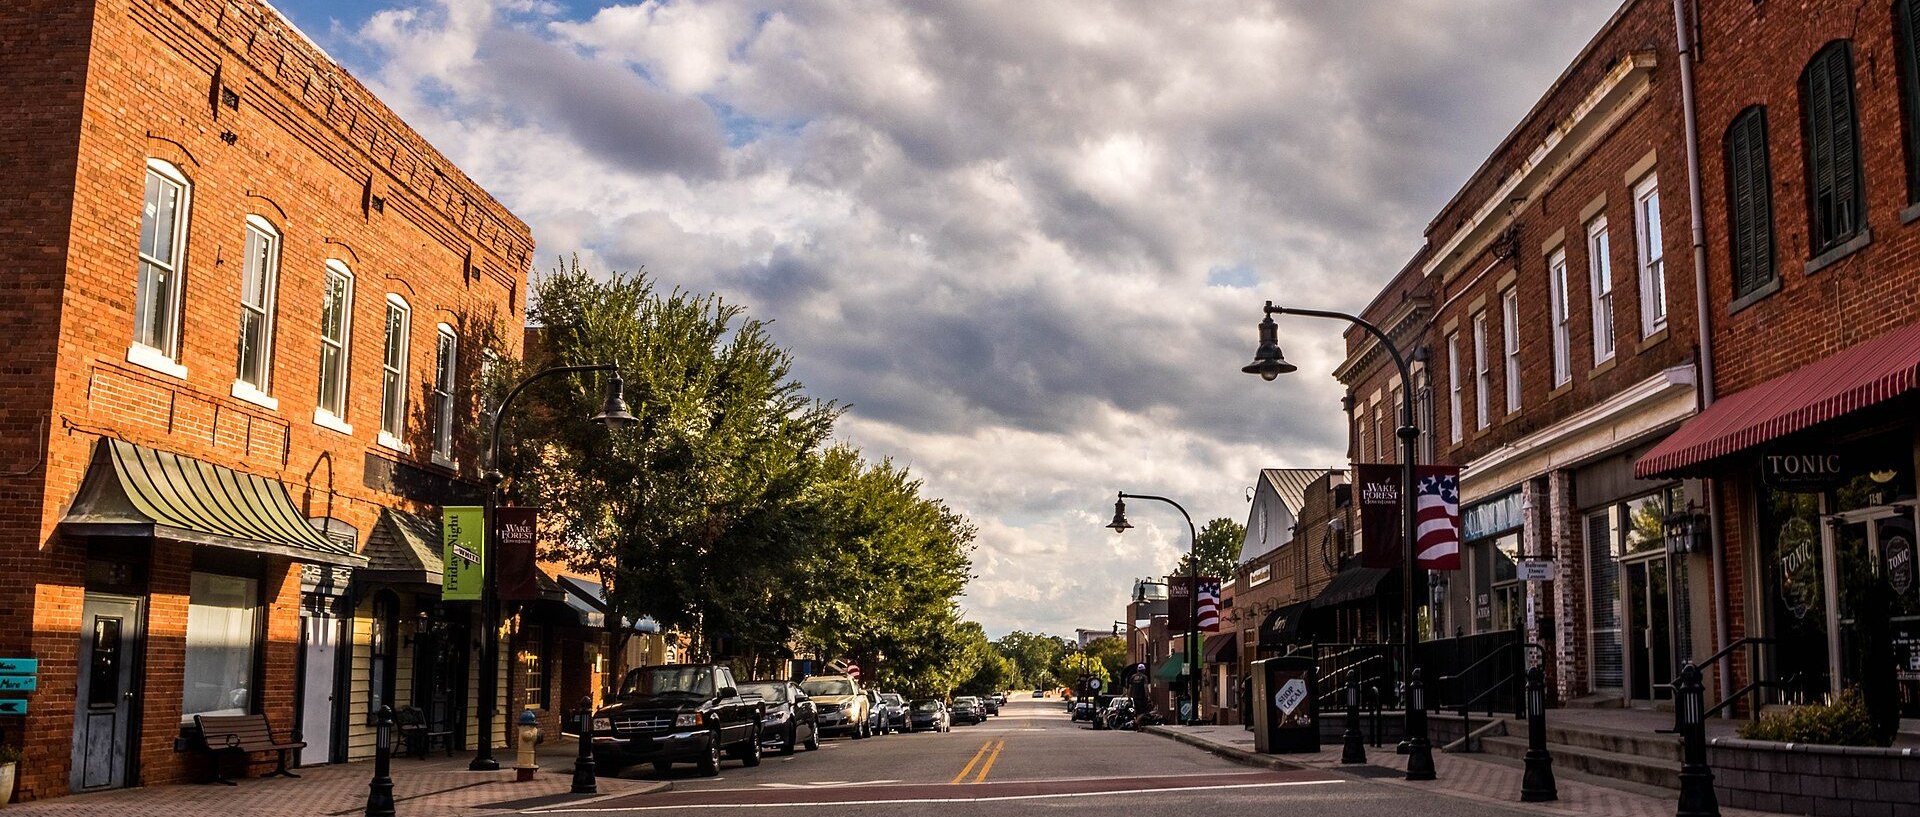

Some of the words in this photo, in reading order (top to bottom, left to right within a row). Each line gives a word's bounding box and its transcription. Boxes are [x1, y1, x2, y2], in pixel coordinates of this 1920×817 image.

[1767, 454, 1841, 474] TONIC
[1363, 489, 1398, 500] FOREST
[1367, 482, 1395, 492] WAKE
[447, 514, 462, 547] Night
[501, 529, 534, 540] FOREST
[505, 524, 532, 533] WAKE
[459, 548, 480, 563] WHITE
[1782, 538, 1811, 578] TONIC
[1888, 547, 1909, 571] TONIC
[447, 555, 461, 592] Friday
[1278, 686, 1293, 704] SHOP
[1283, 688, 1304, 709] LOCAL
